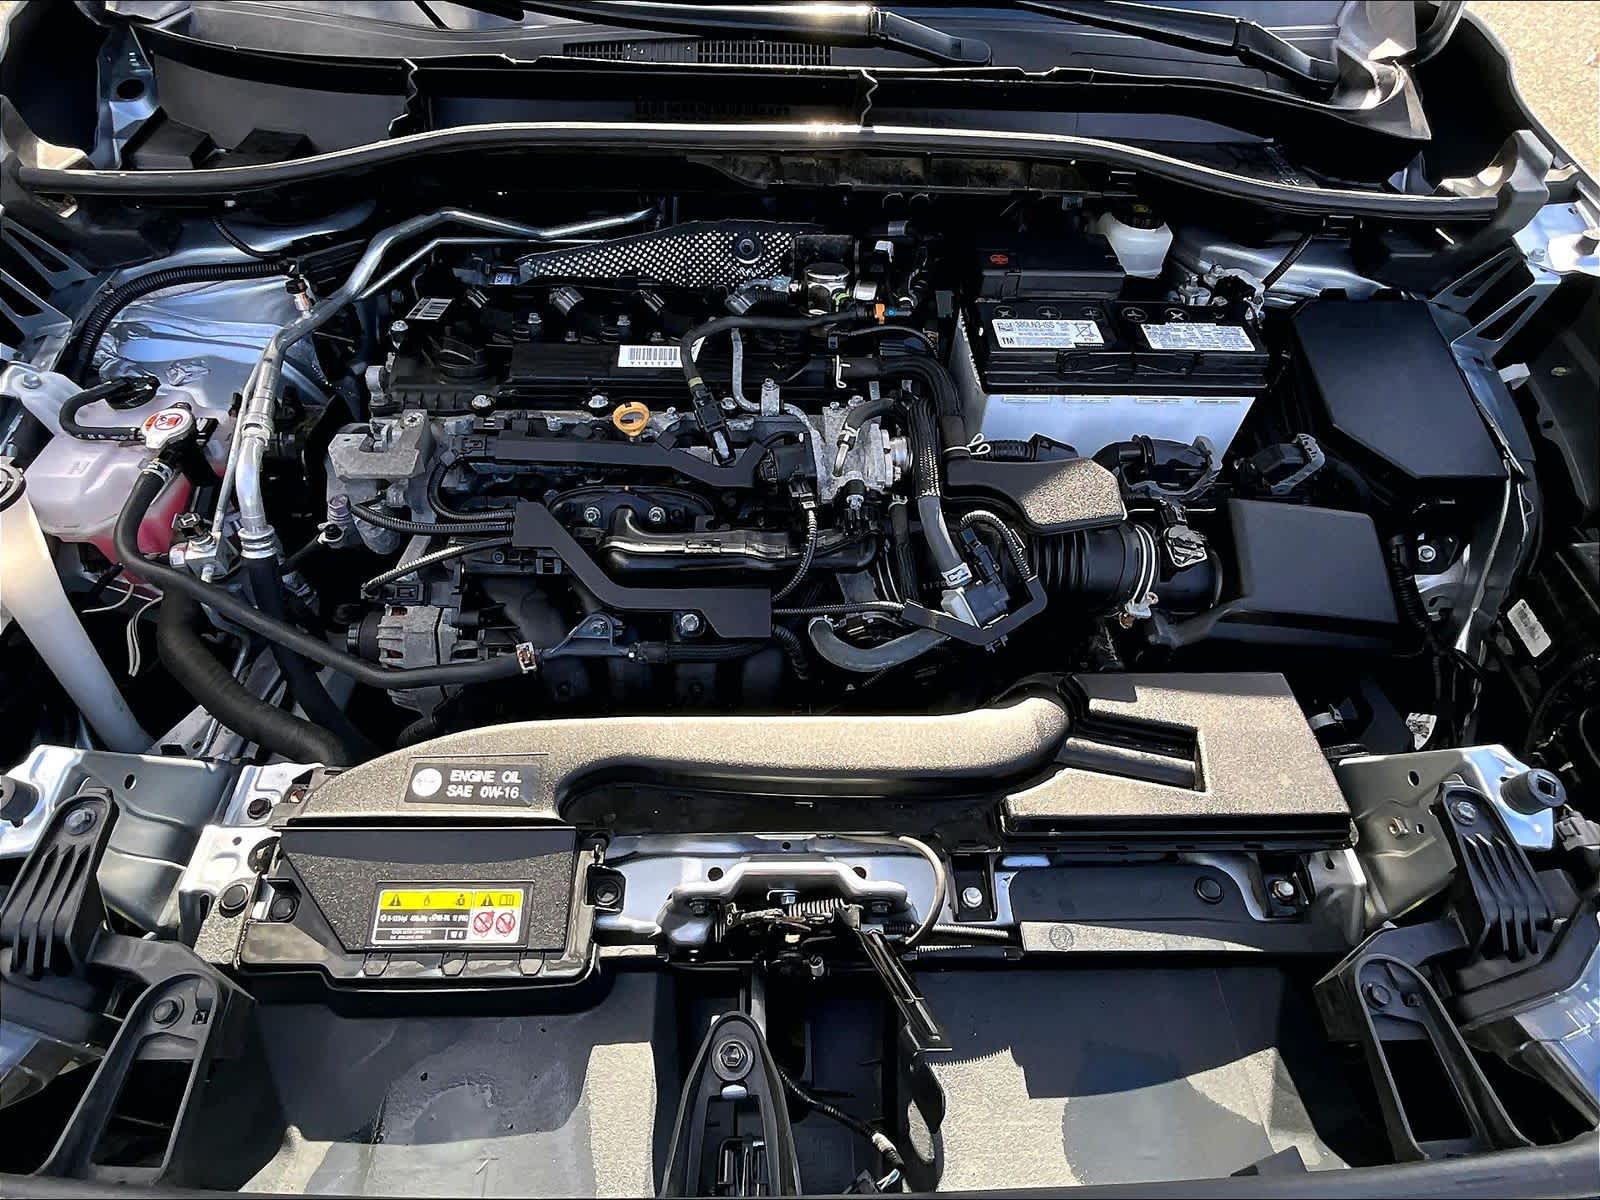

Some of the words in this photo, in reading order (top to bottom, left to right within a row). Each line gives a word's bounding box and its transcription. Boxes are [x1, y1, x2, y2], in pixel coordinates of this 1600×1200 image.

[449, 769, 496, 783] ENGINE
[501, 770, 522, 784] OIL
[446, 784, 474, 798] SAE
[479, 785, 520, 799] 0W-16
